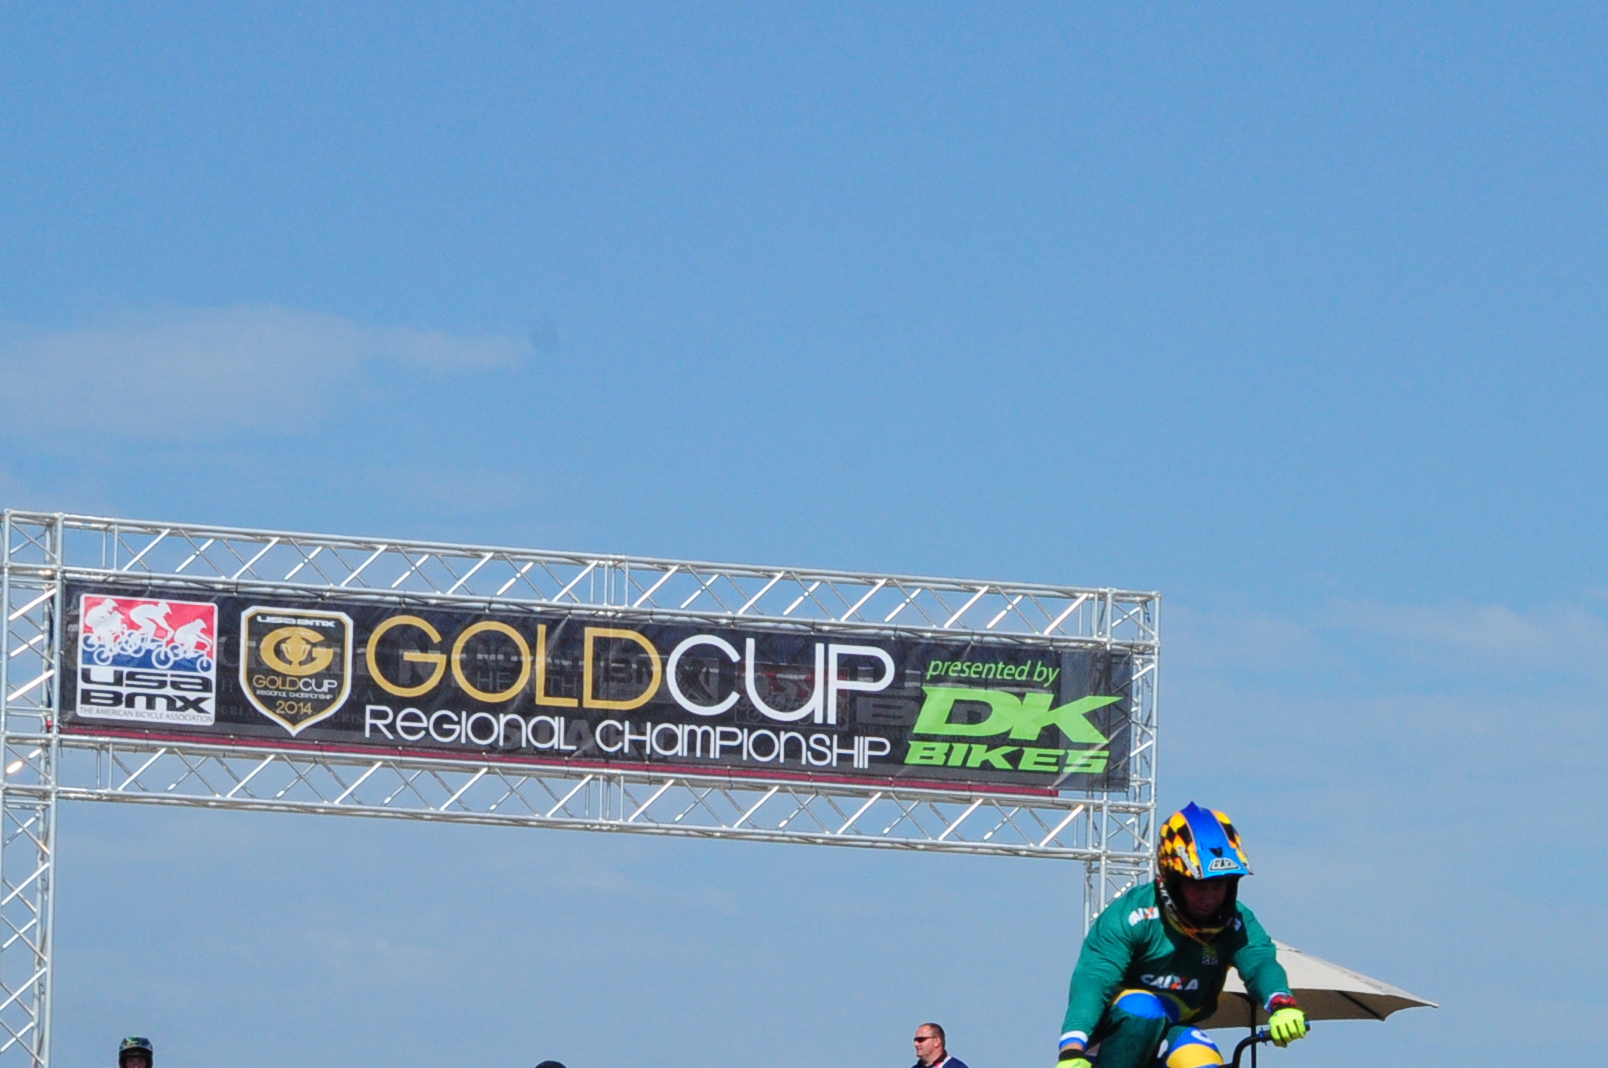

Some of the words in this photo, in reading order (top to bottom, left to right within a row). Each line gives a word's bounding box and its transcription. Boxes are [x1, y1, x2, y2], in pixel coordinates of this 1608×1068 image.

[926, 660, 1031, 681] presented
[1033, 661, 1060, 688] by
[80, 706, 93, 714] THE
[95, 708, 133, 717] AMERICAN
[135, 711, 164, 720] BICYCLE
[165, 713, 213, 723] ASSOCIATION
[275, 701, 313, 715] 2014
[912, 686, 1123, 744] DK
[904, 740, 1110, 774] BIKES
[1140, 974, 1199, 990] CAIXA
